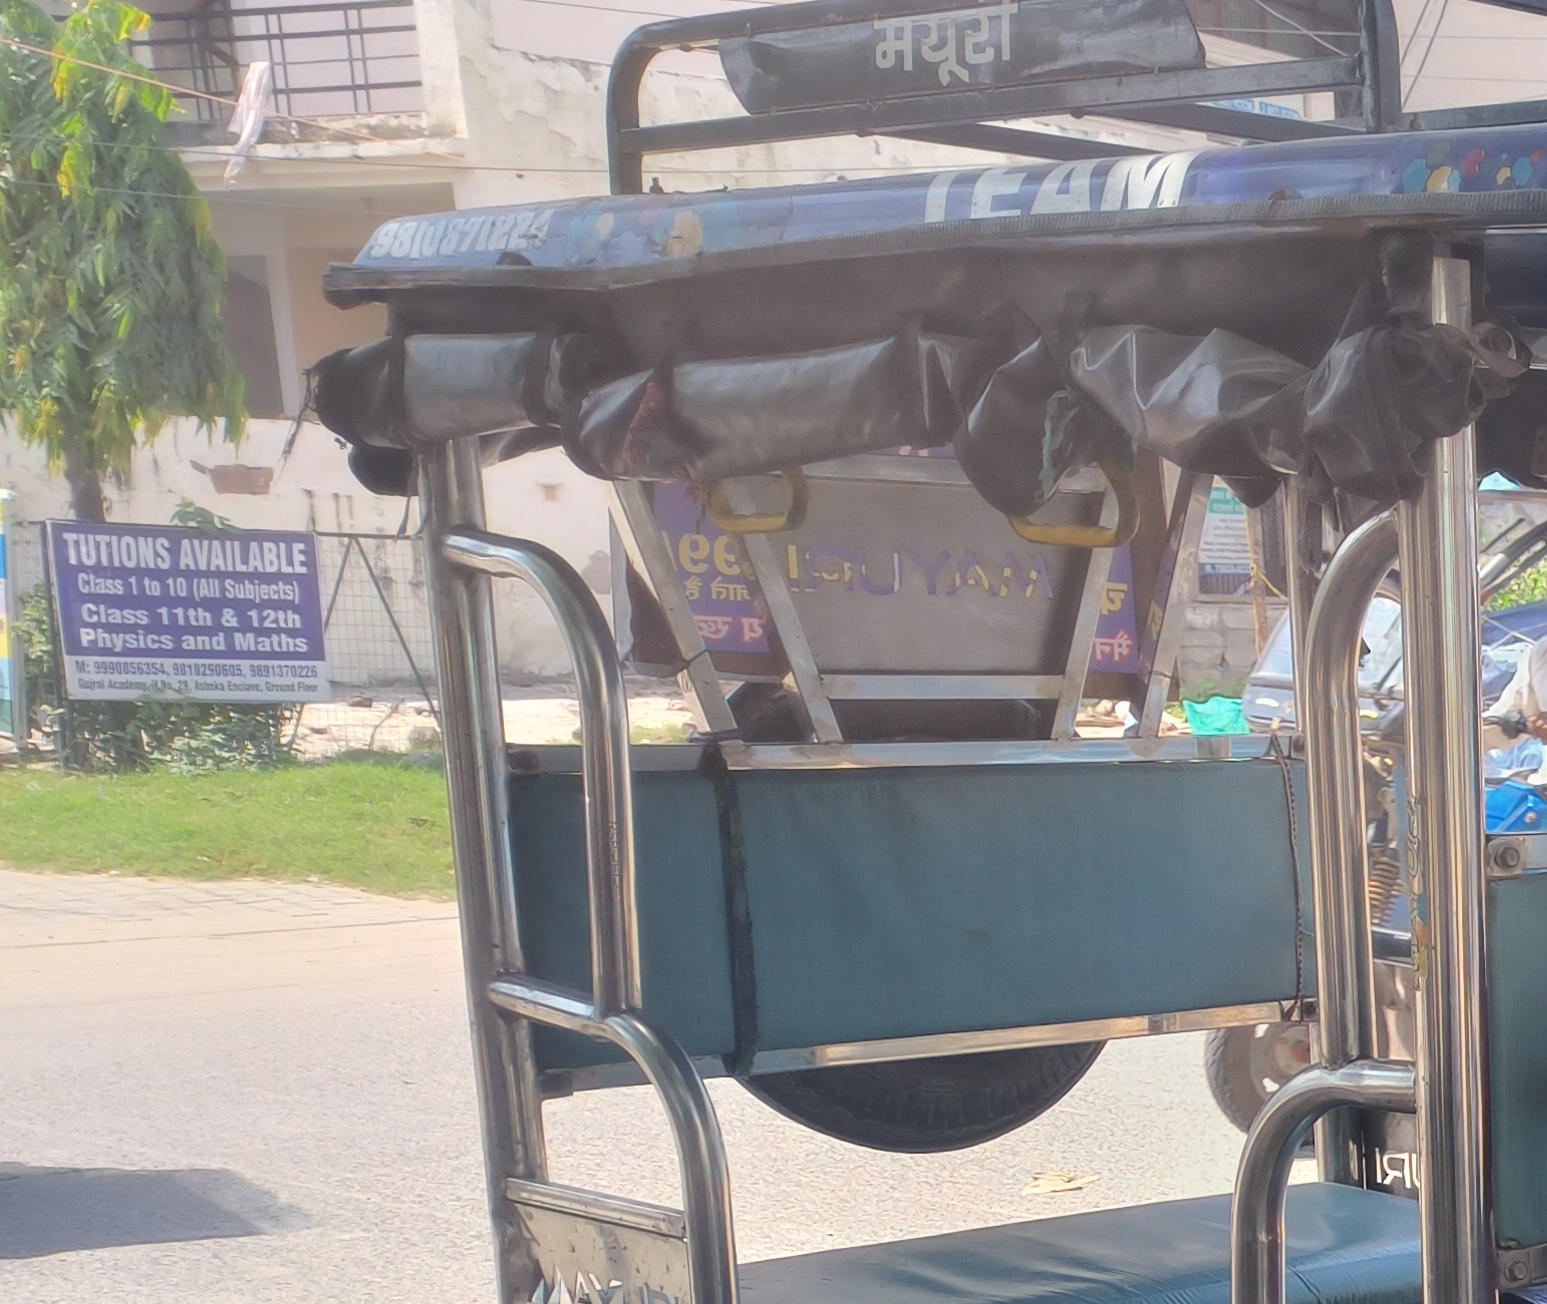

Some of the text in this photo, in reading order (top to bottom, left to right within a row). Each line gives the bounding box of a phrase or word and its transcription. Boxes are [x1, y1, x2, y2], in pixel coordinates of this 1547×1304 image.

[62, 532, 308, 574] TUTIONS AVAILABLE
[78, 573, 299, 604] Class 1 to 10 (All Subjects)
[81, 603, 302, 629] Class 11th & 12th
[80, 627, 309, 653] Physics and Maths
[75, 660, 91, 675] M:
